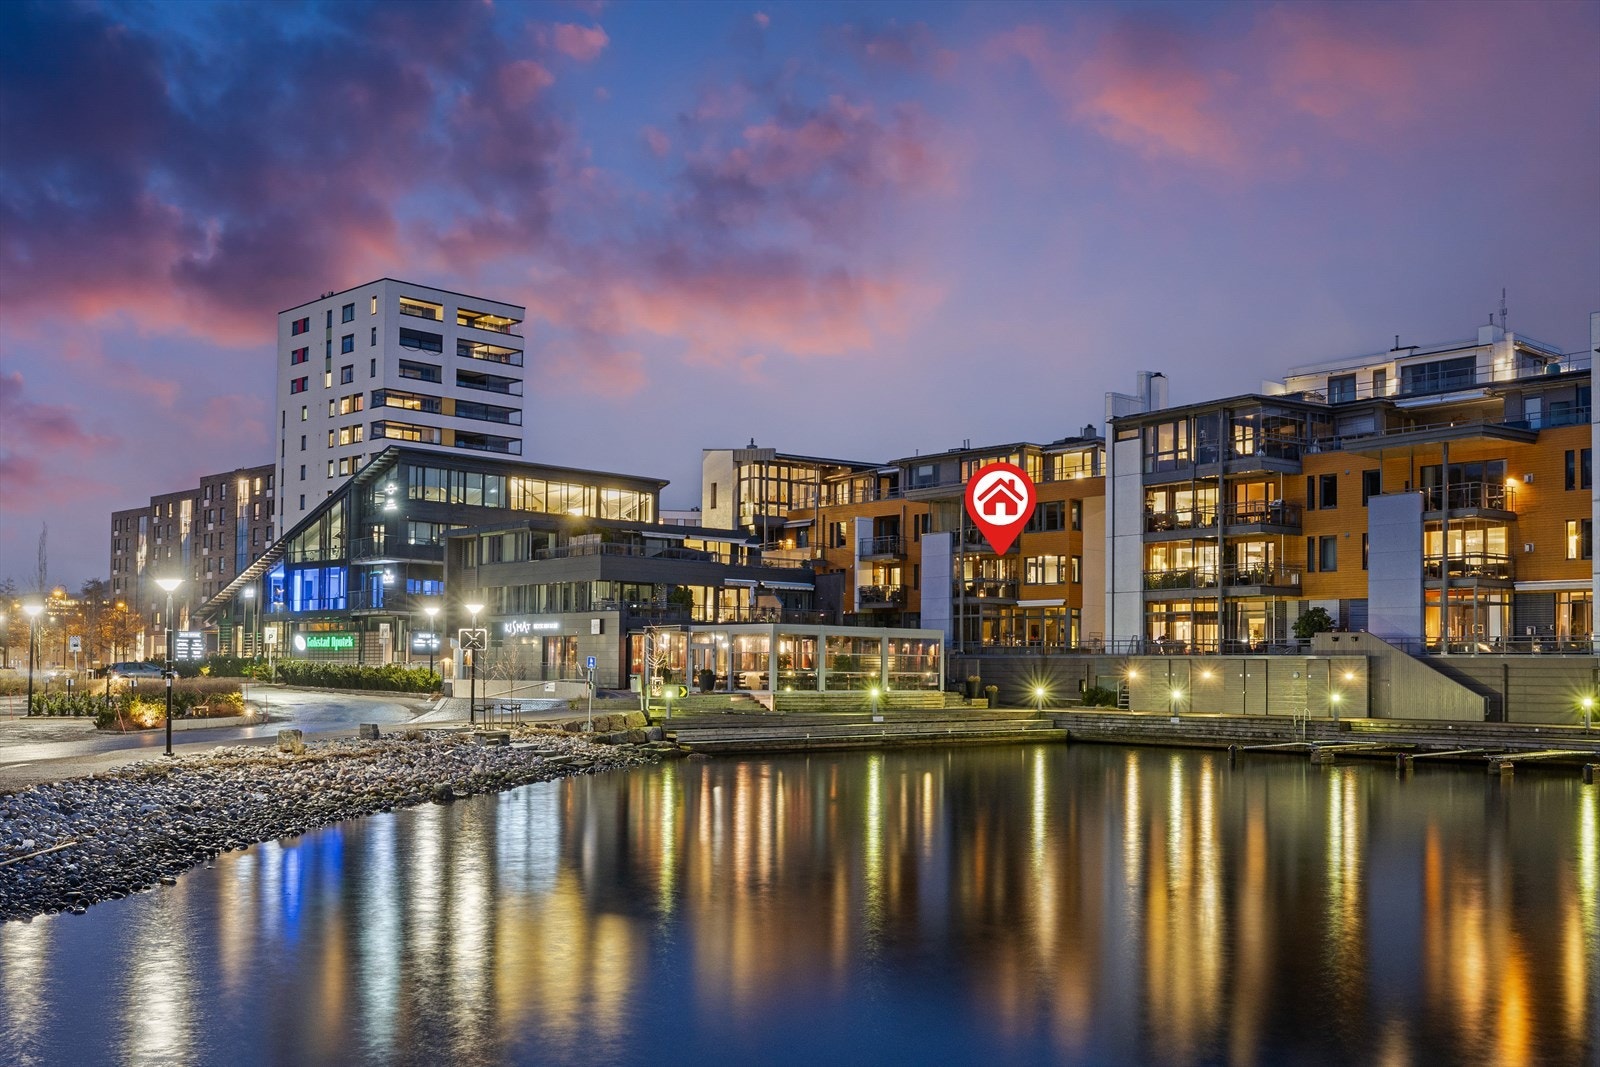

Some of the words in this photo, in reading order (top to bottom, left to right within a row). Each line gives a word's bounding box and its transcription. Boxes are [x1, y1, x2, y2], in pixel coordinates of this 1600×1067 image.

[504, 620, 531, 636] KISMAT
[268, 633, 274, 641] P
[307, 636, 330, 647] Gokstad
[331, 636, 354, 651] Apotek
